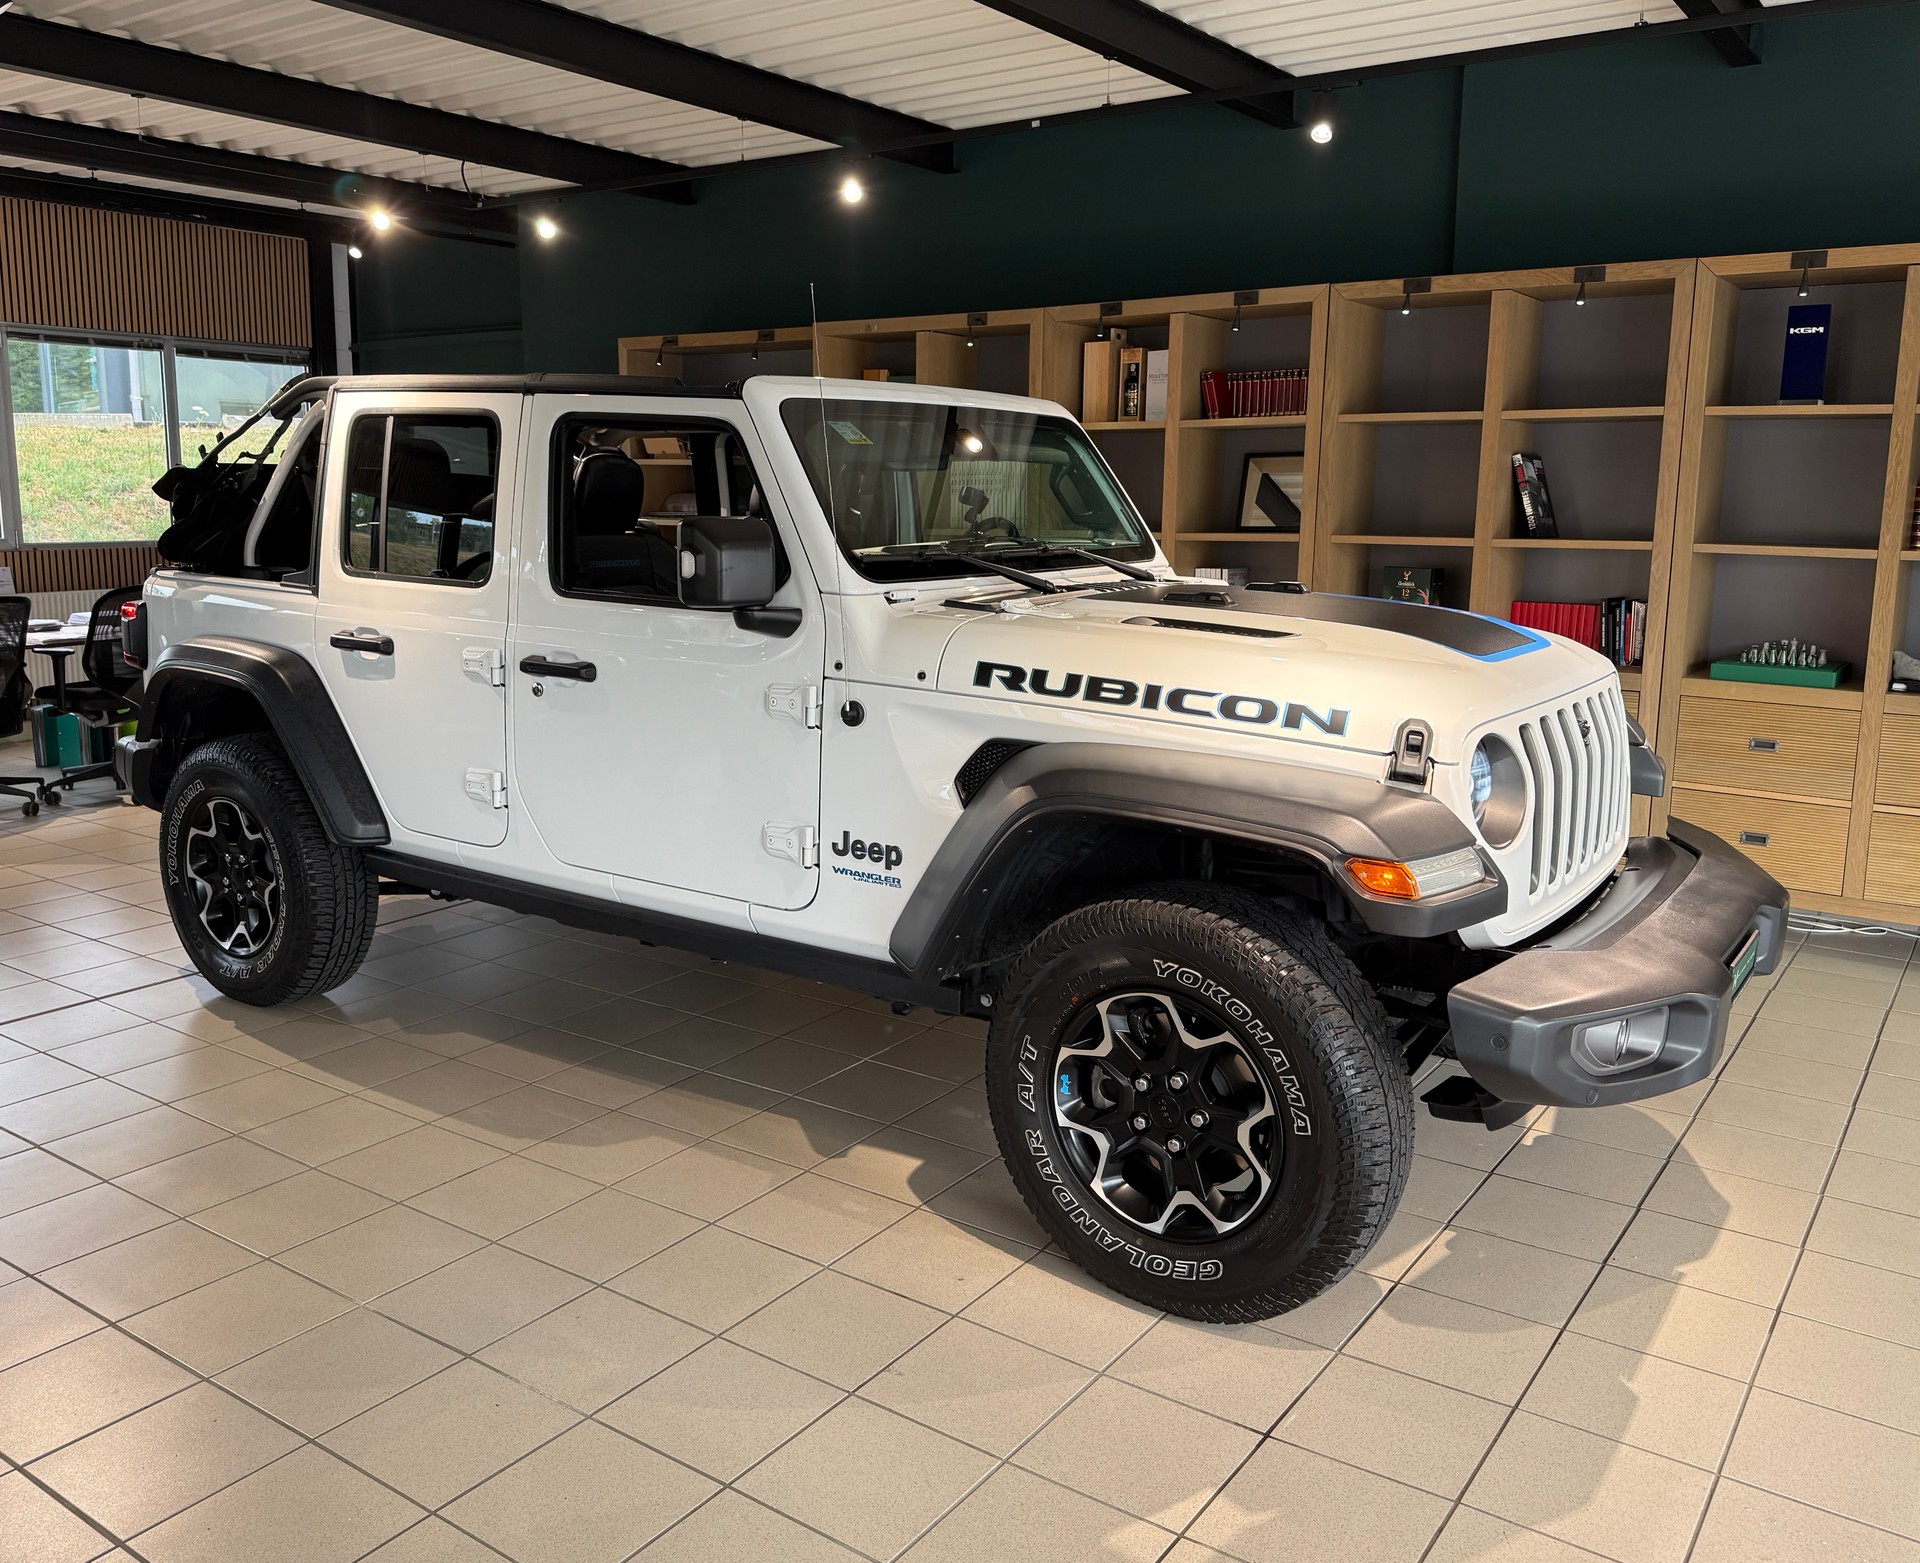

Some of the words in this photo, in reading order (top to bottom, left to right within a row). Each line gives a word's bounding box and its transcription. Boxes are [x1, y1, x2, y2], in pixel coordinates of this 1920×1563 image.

[1789, 326, 1824, 334] KGM
[1526, 516, 1536, 530] 1200
[1402, 588, 1410, 597] 12
[972, 660, 1351, 738] RUBICON
[167, 779, 205, 886] YOKOHAMA
[831, 830, 903, 871] Jeep
[832, 865, 901, 885] WRANGLER
[853, 876, 902, 889] UNLIMITED
[219, 963, 254, 979] A/T
[1152, 958, 1313, 1137] YOKOHAMA
[1018, 1034, 1041, 1113] A/T
[1026, 1128, 1224, 1281] GEOLANDAR
